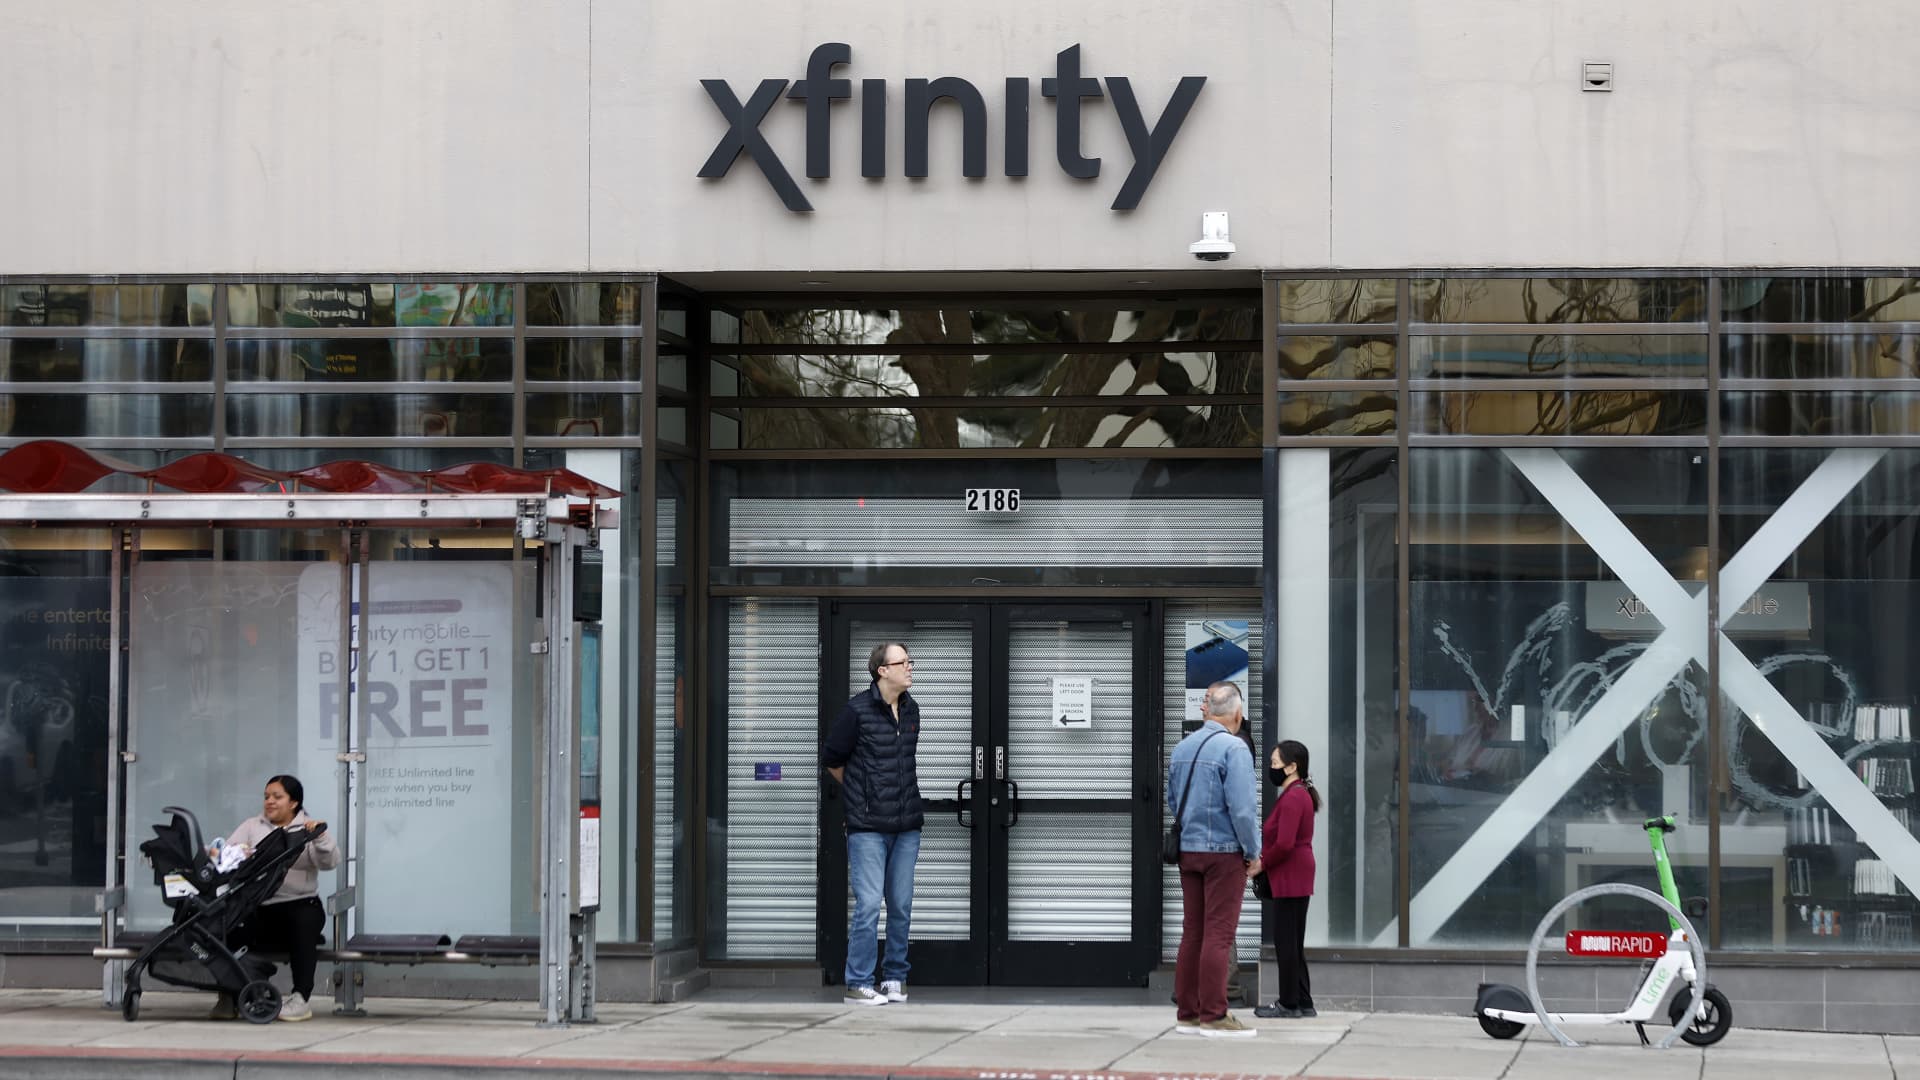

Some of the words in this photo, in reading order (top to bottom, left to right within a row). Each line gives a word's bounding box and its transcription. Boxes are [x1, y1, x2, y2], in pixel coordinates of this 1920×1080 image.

[697, 43, 1207, 211] xfinity
[967, 489, 1019, 511] 2186
[414, 647, 471, 671] GET
[480, 647, 489, 671] 1
[319, 678, 490, 739] FREE
[399, 767, 453, 779] Unlimited
[455, 766, 475, 777] line
[394, 782, 425, 793] when
[428, 783, 448, 795] you
[451, 782, 472, 795] buy
[378, 797, 433, 809] Unlimited
[435, 796, 456, 808] line
[1611, 937, 1653, 953] RAPID
